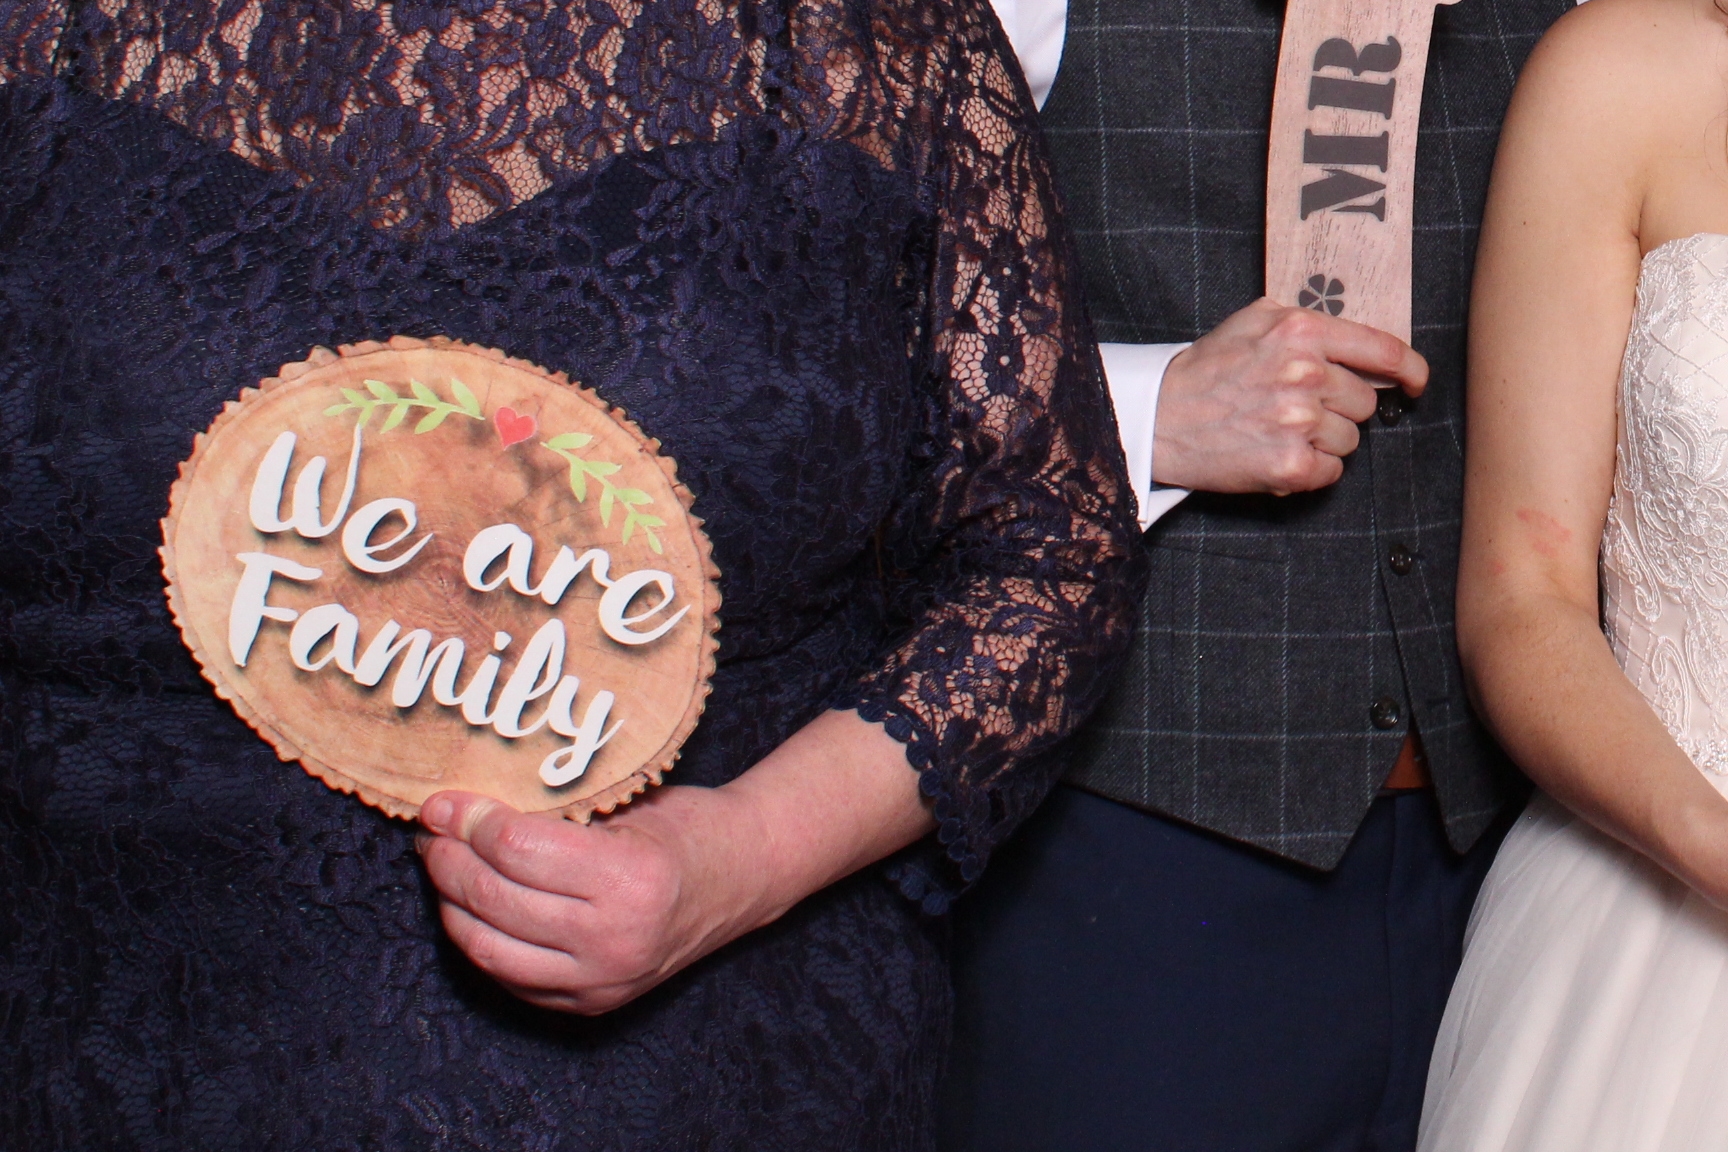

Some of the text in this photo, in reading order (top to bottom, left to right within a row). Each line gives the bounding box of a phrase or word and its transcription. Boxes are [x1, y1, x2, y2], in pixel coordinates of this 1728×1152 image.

[1300, 35, 1402, 221] MR
[249, 423, 690, 645] We are
[228, 552, 624, 787] Family
